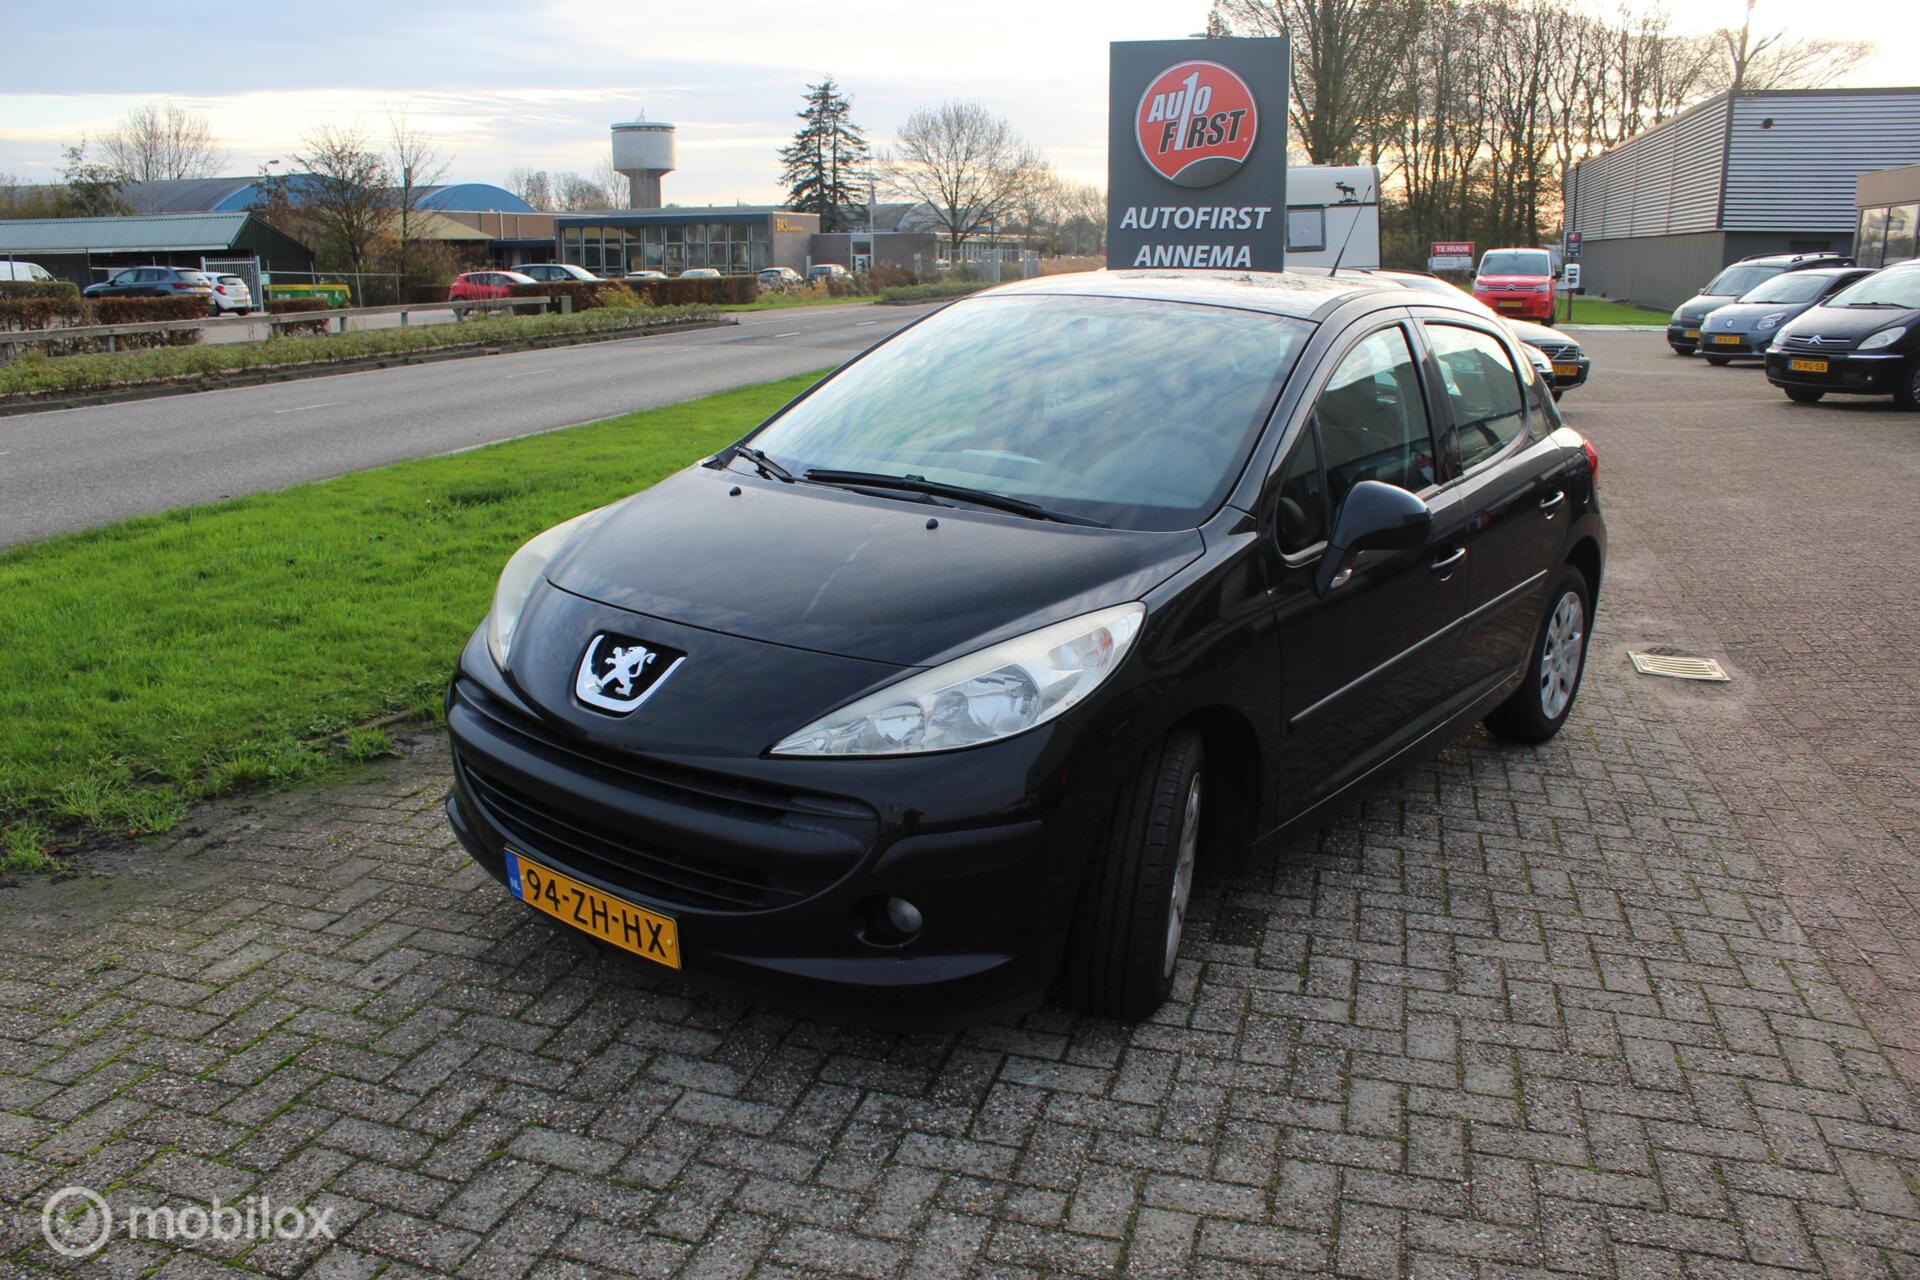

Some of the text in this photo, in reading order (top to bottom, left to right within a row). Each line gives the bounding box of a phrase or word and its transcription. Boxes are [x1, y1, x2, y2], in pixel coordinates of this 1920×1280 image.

[1120, 206, 1271, 230] AUTOFIRST
[1133, 244, 1252, 268] ANNEMA
[1436, 245, 1469, 253] TE HUUR
[526, 868, 667, 958] 94-ZH-HX
